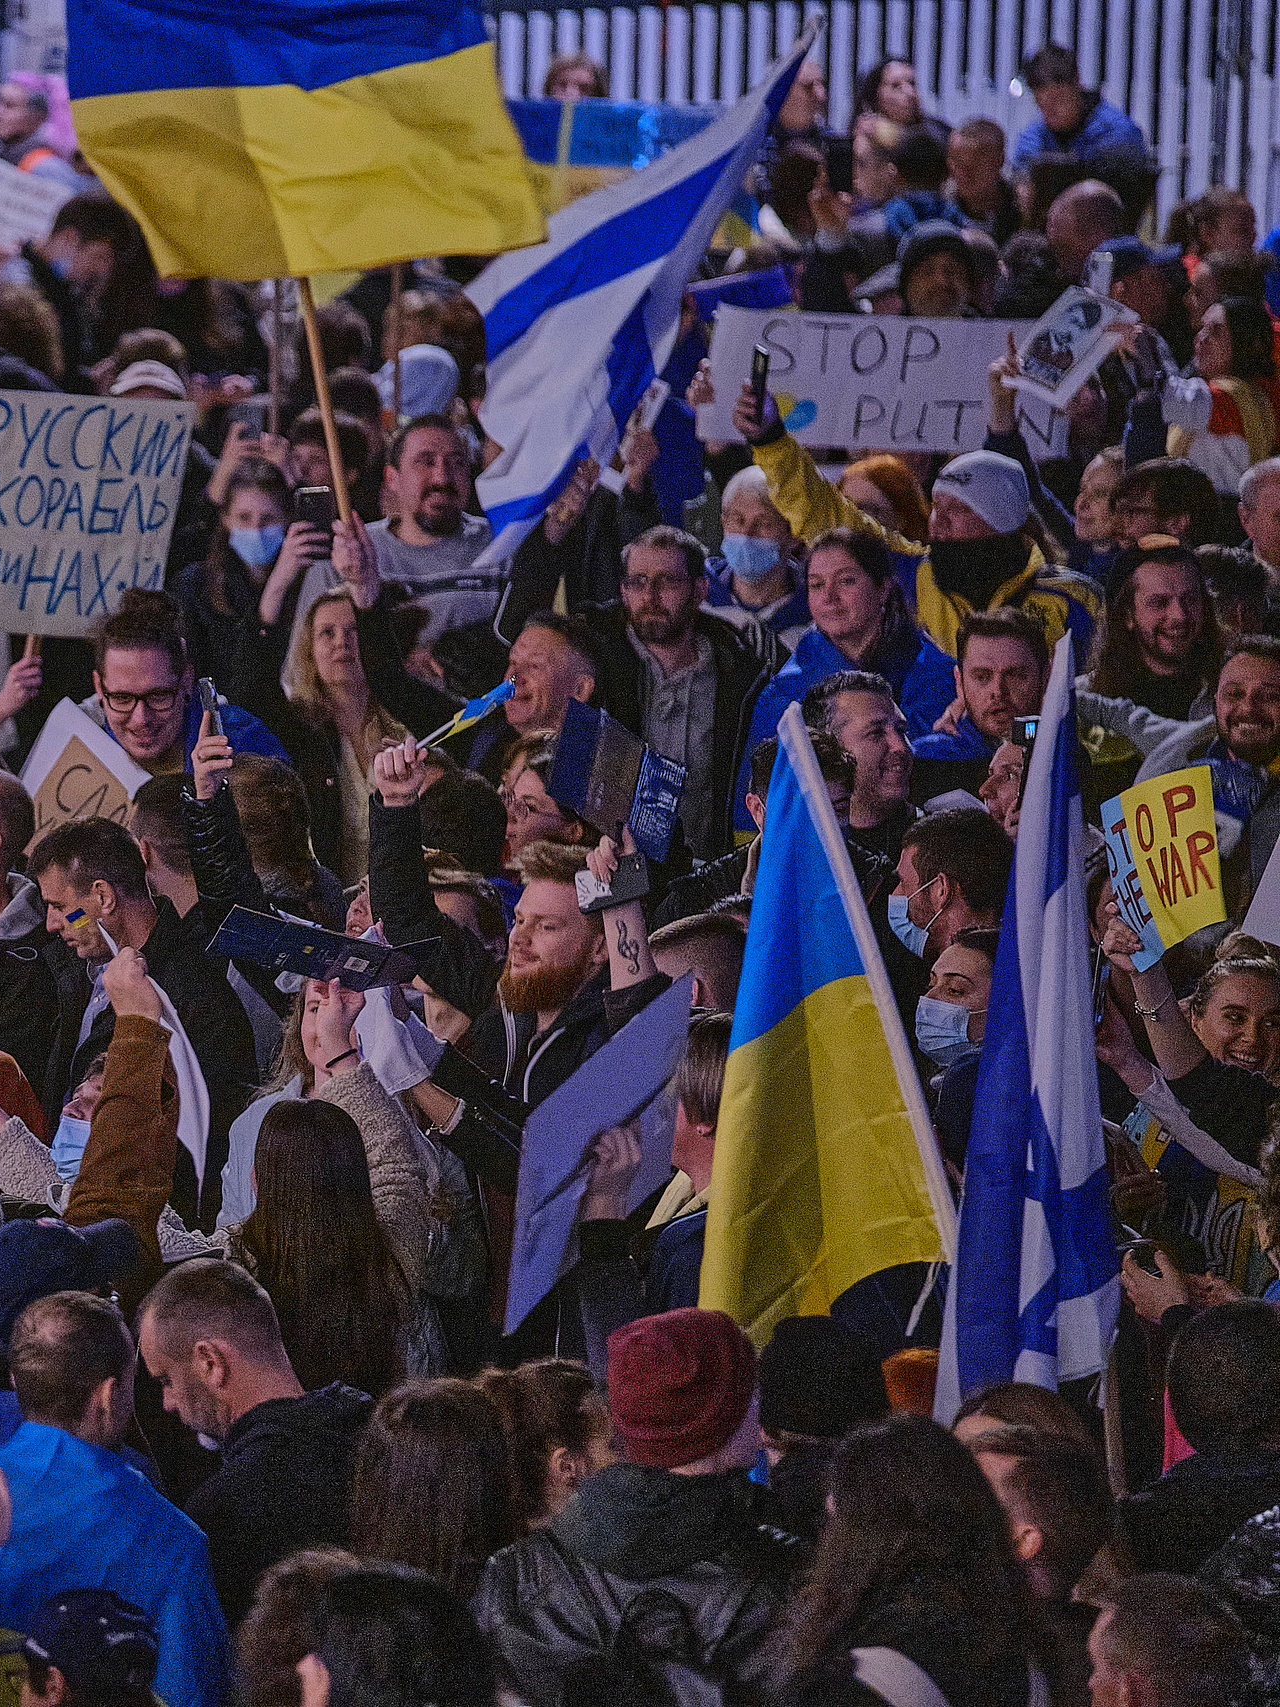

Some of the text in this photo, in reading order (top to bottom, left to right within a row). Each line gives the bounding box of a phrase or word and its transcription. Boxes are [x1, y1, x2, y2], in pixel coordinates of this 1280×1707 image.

[761, 317, 941, 383] STOP
[852, 393, 1056, 447] PUTN
[1146, 830, 1216, 909] WAR
